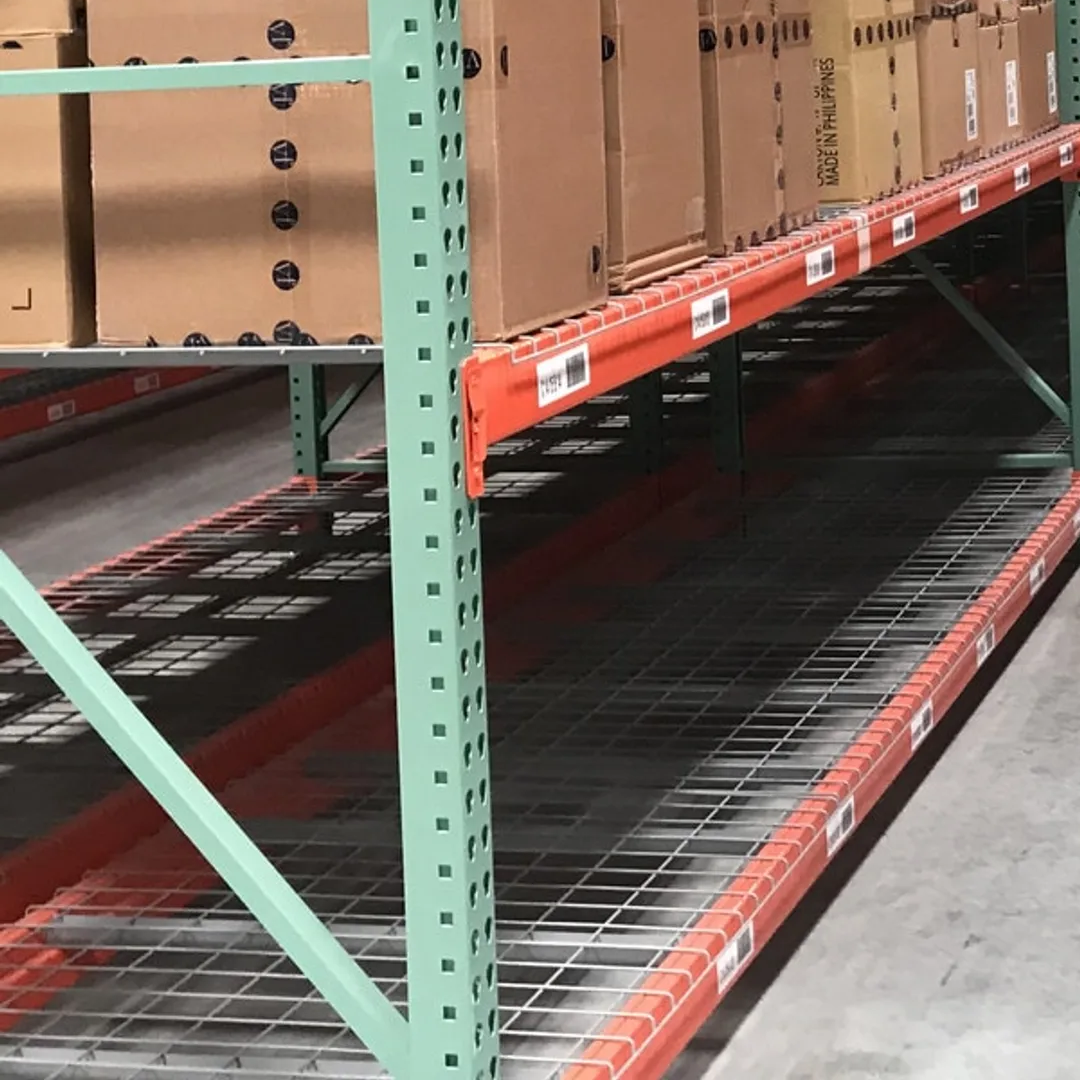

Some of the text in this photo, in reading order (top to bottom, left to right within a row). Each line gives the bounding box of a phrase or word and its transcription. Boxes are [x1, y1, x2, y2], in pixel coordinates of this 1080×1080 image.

[819, 57, 839, 186] MADE IN PHILIPPINES
